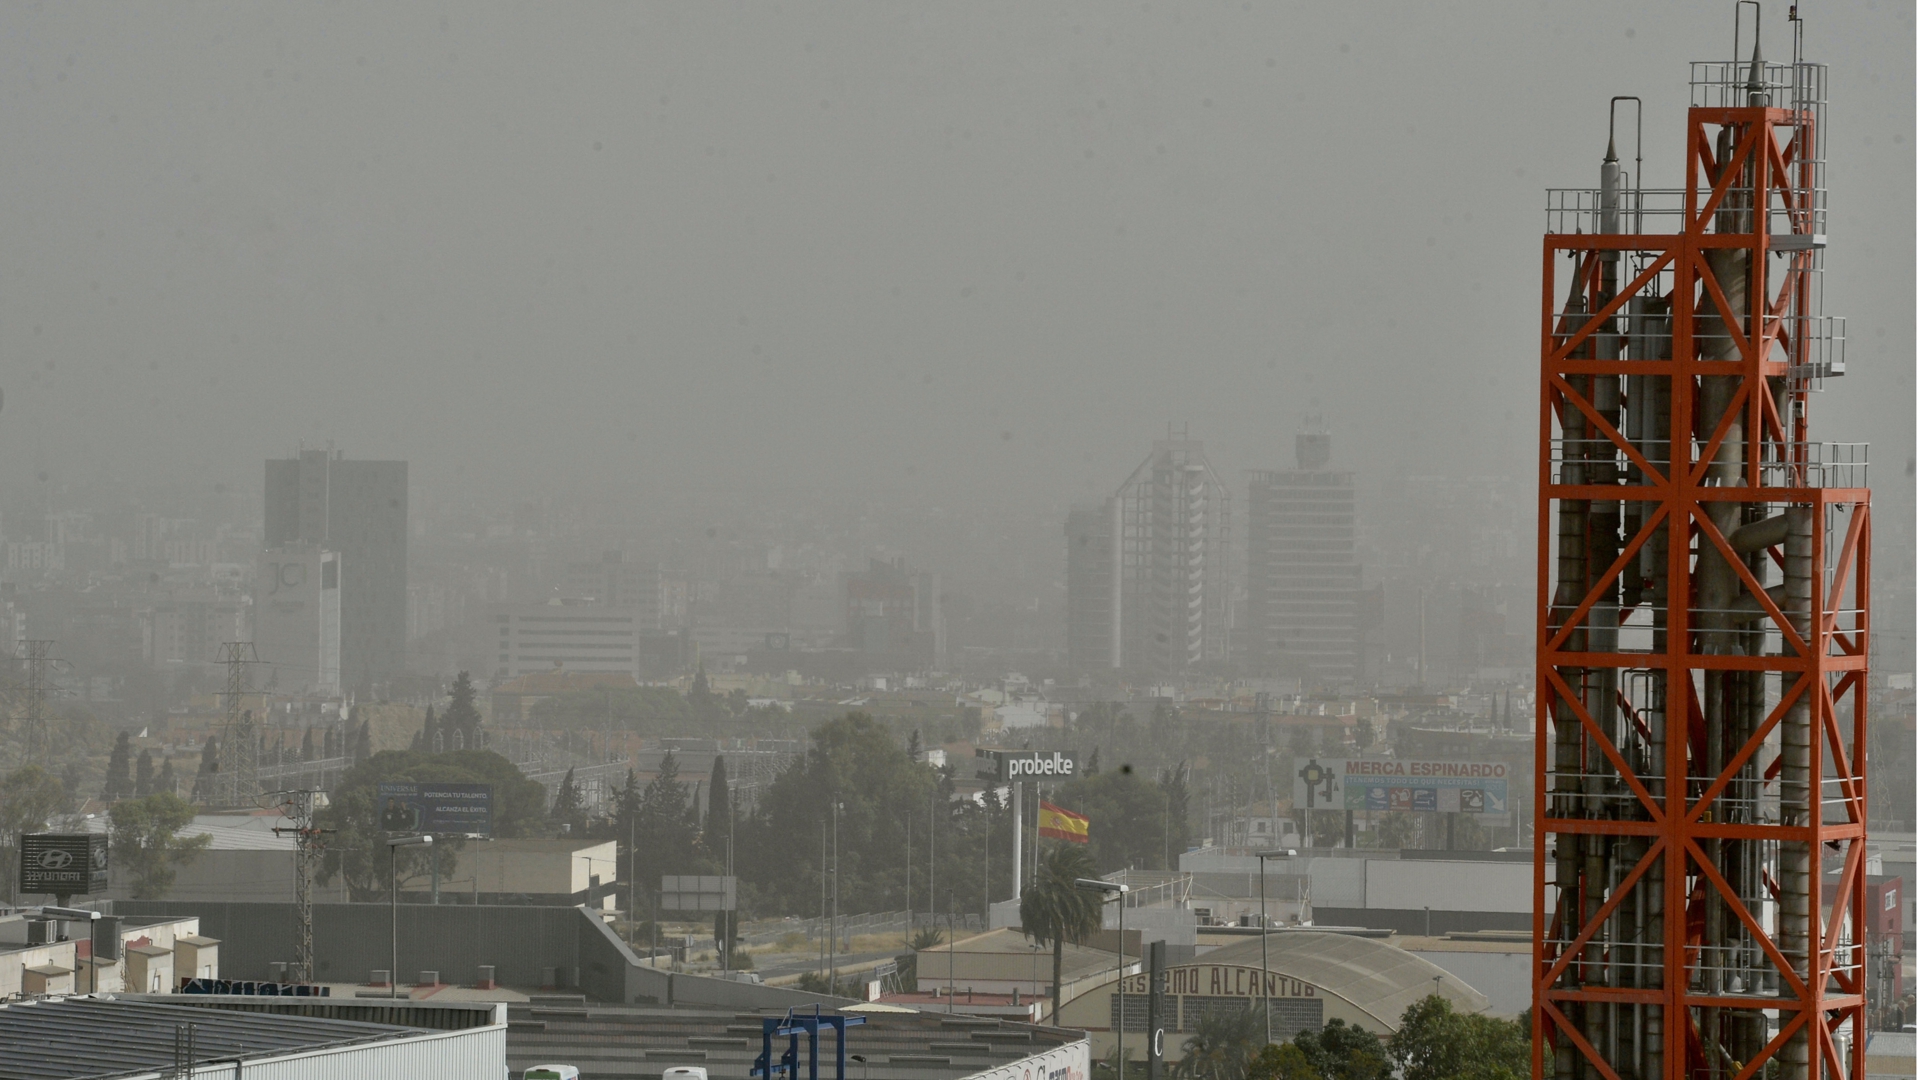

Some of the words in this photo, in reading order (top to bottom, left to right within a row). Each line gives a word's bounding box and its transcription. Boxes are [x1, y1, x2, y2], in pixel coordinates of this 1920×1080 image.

[1008, 752, 1073, 779] probelte
[1345, 761, 1405, 775] MERCA
[1410, 762, 1506, 777] ESPINARDO
[26, 871, 80, 881] HYUNDAI
[1117, 968, 1199, 994] sisema
